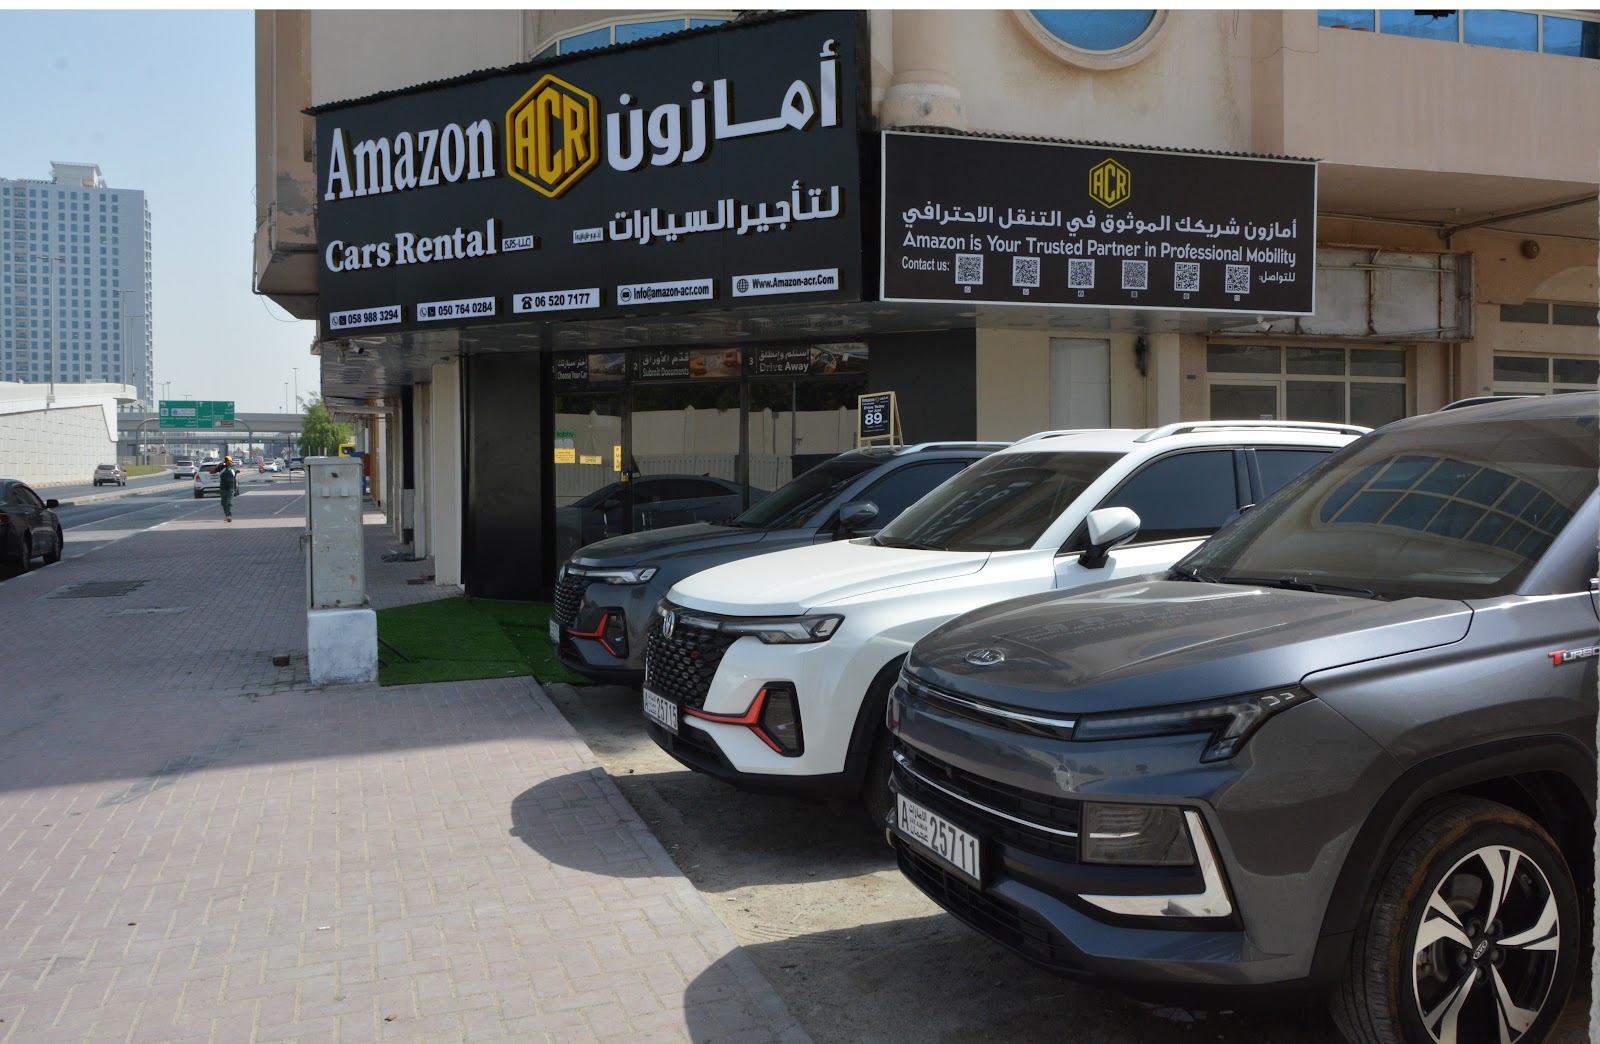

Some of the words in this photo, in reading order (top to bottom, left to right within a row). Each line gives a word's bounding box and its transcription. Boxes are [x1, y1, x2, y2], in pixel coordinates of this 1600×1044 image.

[607, 38, 838, 171] أمازون
[514, 86, 588, 186] ACR
[325, 119, 496, 201] Amazon
[1093, 163, 1127, 204] ACR
[737, 180, 840, 236] لتأجير
[902, 200, 994, 229] الاحترافي
[998, 207, 1062, 230] التنقل
[608, 198, 735, 245] السيارات
[1066, 209, 1097, 237] في
[1100, 211, 1171, 235] الموثوق
[1175, 217, 1241, 238] شريكك
[1244, 218, 1297, 241] أمازون
[325, 239, 392, 273] Cars
[395, 218, 497, 265] Rental
[903, 230, 966, 250] Amazon
[970, 234, 982, 251] is
[986, 235, 1022, 253] Your
[1025, 236, 1083, 256] Trusted
[1087, 239, 1141, 257] Partner
[1144, 241, 1157, 257] in
[1160, 242, 1243, 262] Professional
[1246, 247, 1297, 267] Mobility
[902, 256, 935, 271] Contact
[937, 259, 950, 272] us:
[633, 284, 710, 301] Info@amazon-acr.com
[752, 274, 834, 289] Www.Amazon-acr.Com
[438, 305, 453, 316] 050
[455, 303, 470, 315] 764
[472, 301, 493, 314] 0284
[534, 296, 547, 308] 06
[548, 294, 565, 307] 520
[567, 292, 591, 305] 7177
[347, 313, 362, 325] 058
[363, 311, 378, 323] 988
[379, 309, 399, 322] 3294
[633, 363, 638, 371] 2
[642, 367, 661, 377] Submit
[661, 366, 690, 377] Documents
[760, 362, 783, 372] Drive
[785, 361, 809, 373] Away
[864, 412, 882, 425] 89
[657, 697, 677, 729] 25715
[901, 800, 909, 832] A
[930, 816, 976, 876] 25711
